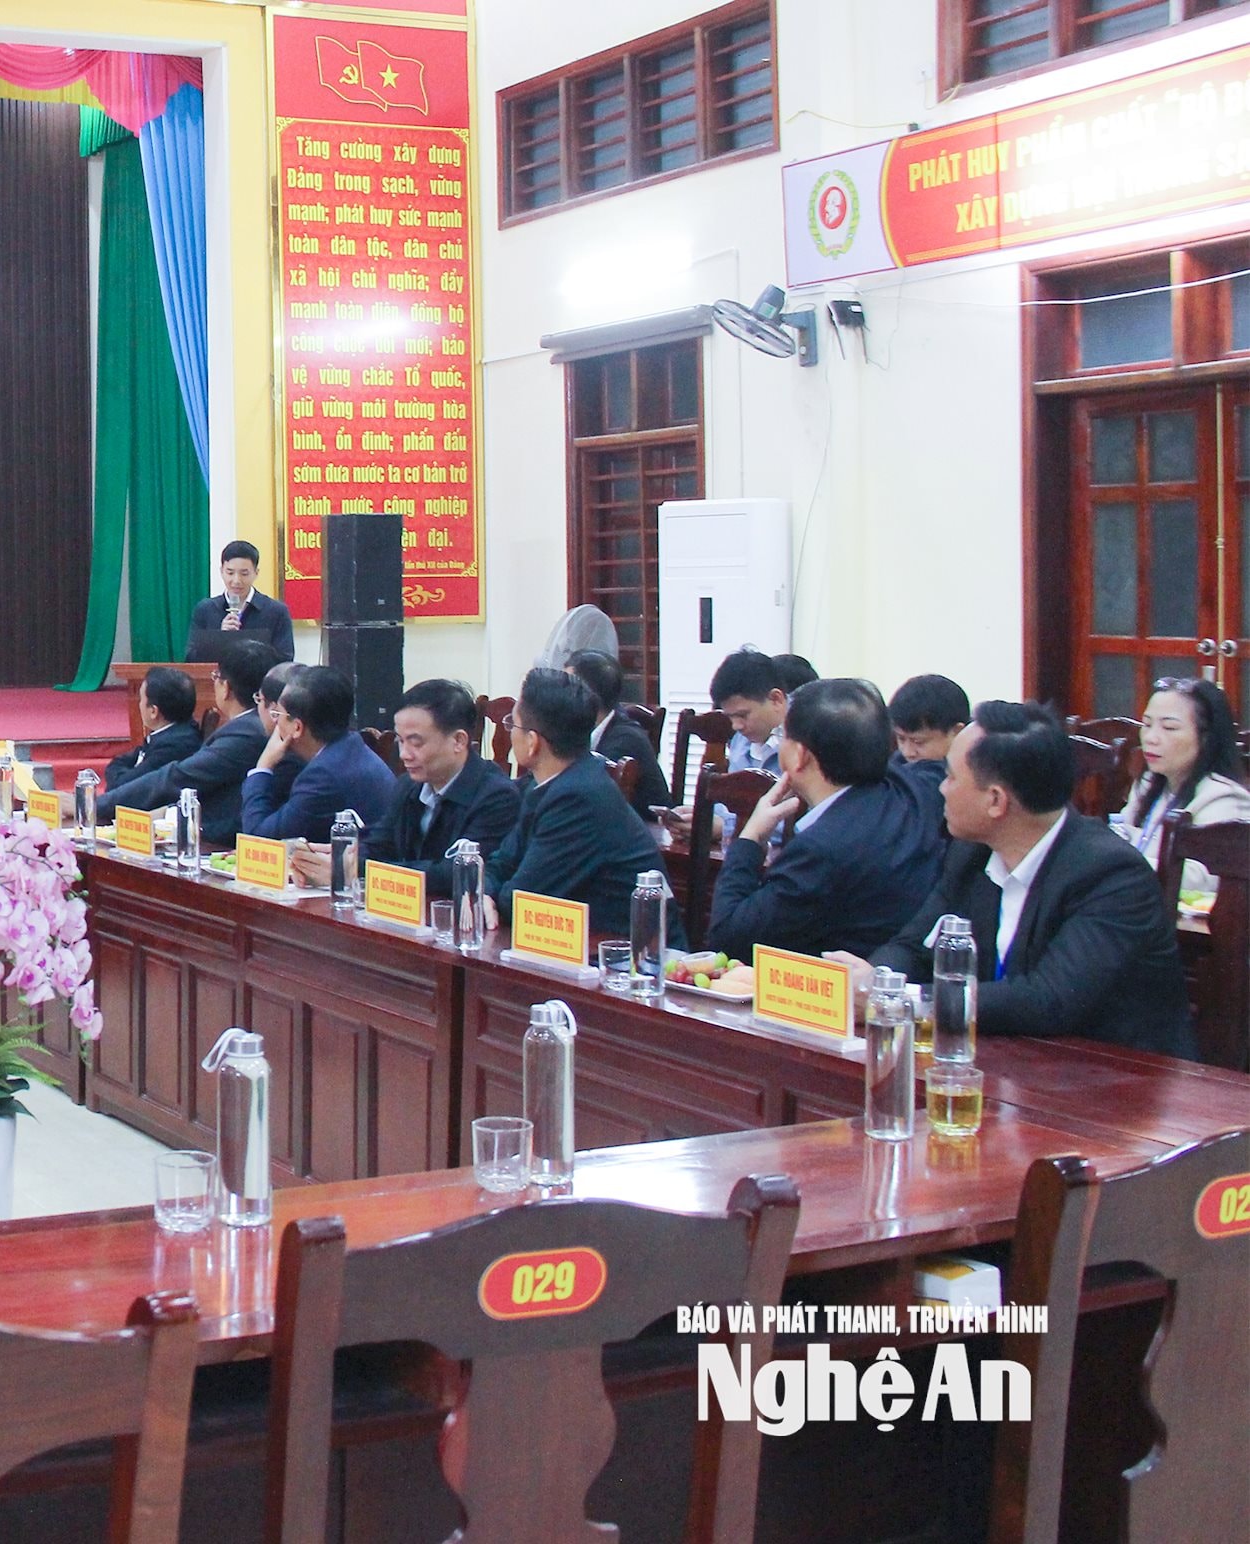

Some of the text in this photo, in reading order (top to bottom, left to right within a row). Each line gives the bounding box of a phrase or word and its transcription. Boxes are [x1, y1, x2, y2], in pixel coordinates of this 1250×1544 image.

[296, 136, 461, 168] Tăng cường xây dựng
[909, 150, 962, 192] PHÁT
[967, 140, 1011, 179] HUY
[287, 166, 462, 198] Đảng trong sạch, vững
[288, 202, 462, 232] mạnh; phát huy sức mạnh
[956, 193, 999, 233] XÂY
[288, 234, 463, 260] toàn dân tộc, dân chủ
[289, 264, 463, 294] xã hội chủ nghĩa; đẩy
[290, 300, 327, 323] mạnh
[335, 301, 364, 320] toàn
[411, 301, 441, 325] đồng
[449, 303, 464, 327] bộ
[291, 332, 324, 353] công
[405, 333, 433, 356] mới;
[442, 333, 465, 355] bảo
[291, 363, 466, 389] vệ vững chắc Tổ quốc,
[292, 396, 466, 421] giữ vững môi trường hòa
[293, 426, 467, 455] bình, ổn định; phấn đấu
[293, 462, 467, 483] sớm đưa nước ta cơ bản trở
[294, 495, 468, 520] thành nước công nghiệp
[428, 528, 453, 552] đại.
[1220, 1184, 1250, 1224] 02
[512, 1261, 576, 1304] 029
